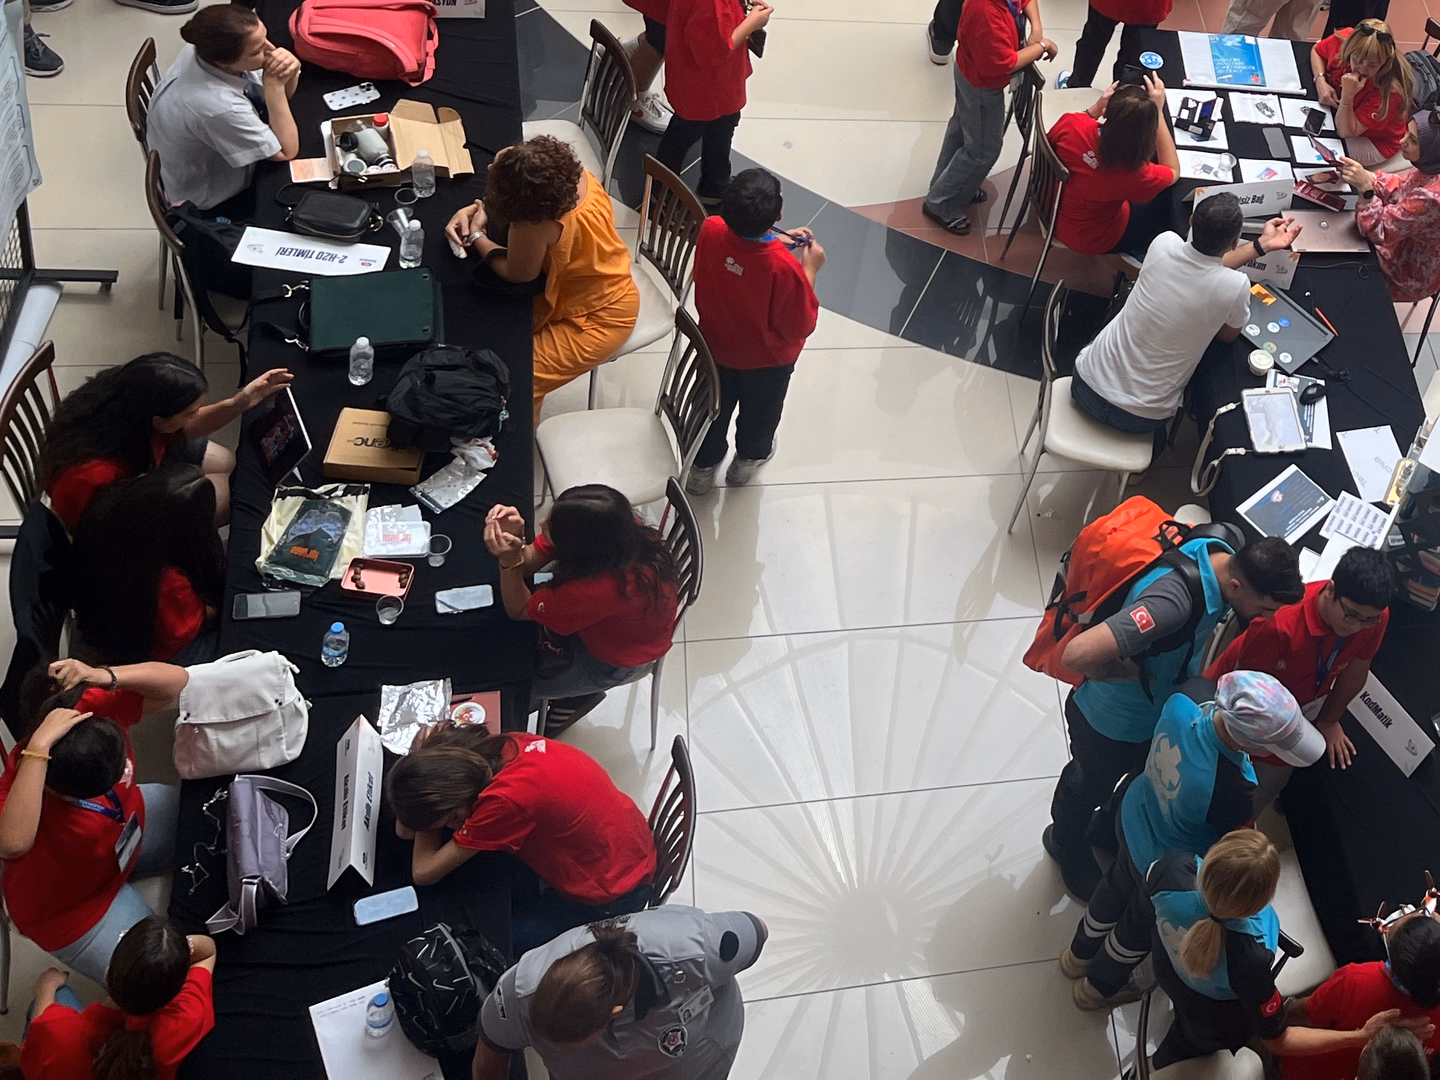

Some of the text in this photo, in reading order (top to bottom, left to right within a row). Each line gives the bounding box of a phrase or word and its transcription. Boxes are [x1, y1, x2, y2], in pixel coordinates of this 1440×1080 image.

[1250, 194, 1264, 205] Bağ
[275, 246, 315, 260] TİMLERİ
[1360, 691, 1394, 730] KodMatik
